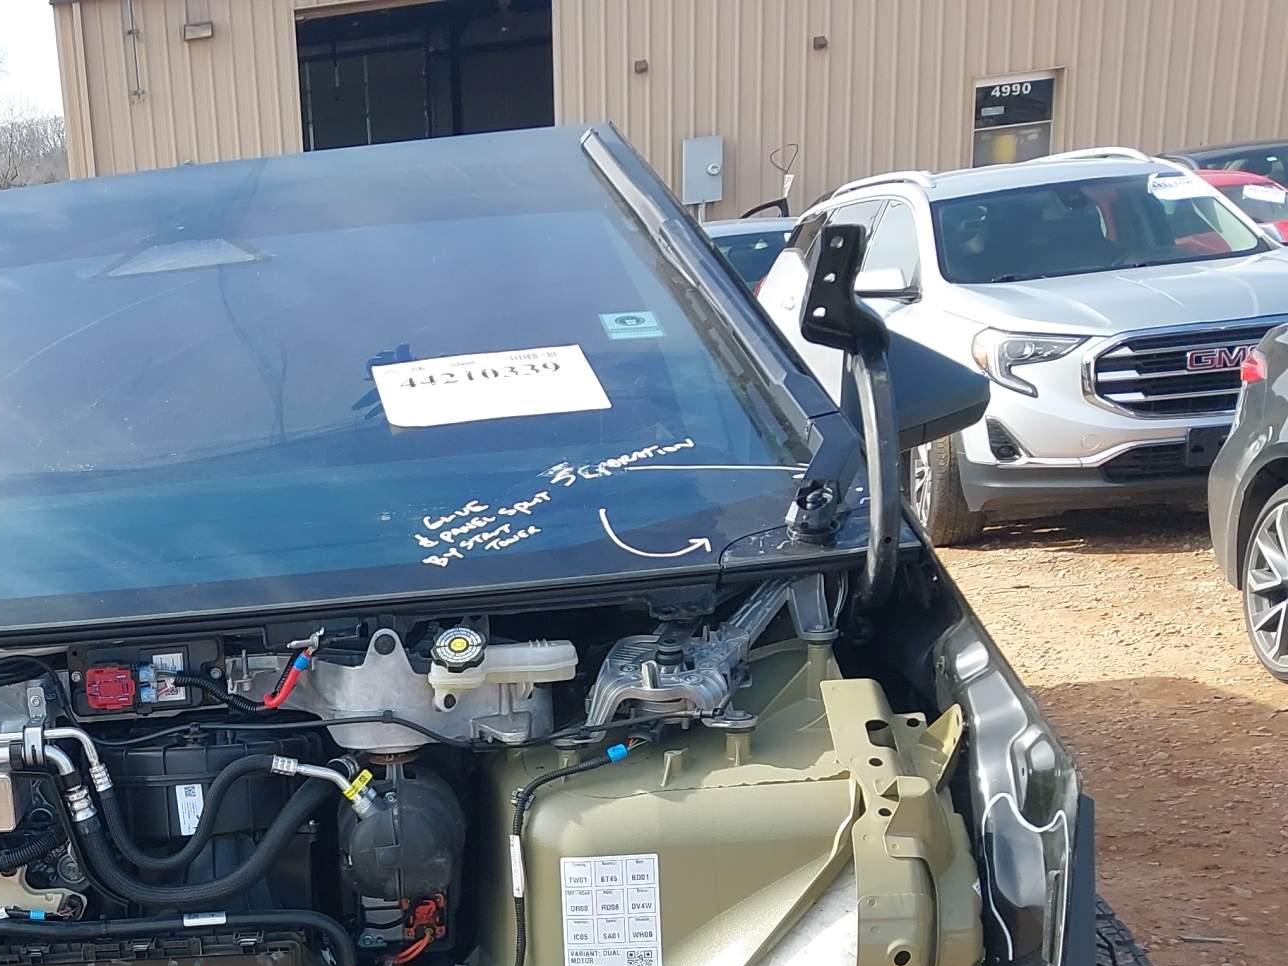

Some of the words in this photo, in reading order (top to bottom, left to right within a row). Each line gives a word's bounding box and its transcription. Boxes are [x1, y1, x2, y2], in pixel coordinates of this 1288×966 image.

[991, 82, 1032, 98] 4990
[1186, 345, 1259, 370] GM
[603, 949, 620, 957] DUAL
